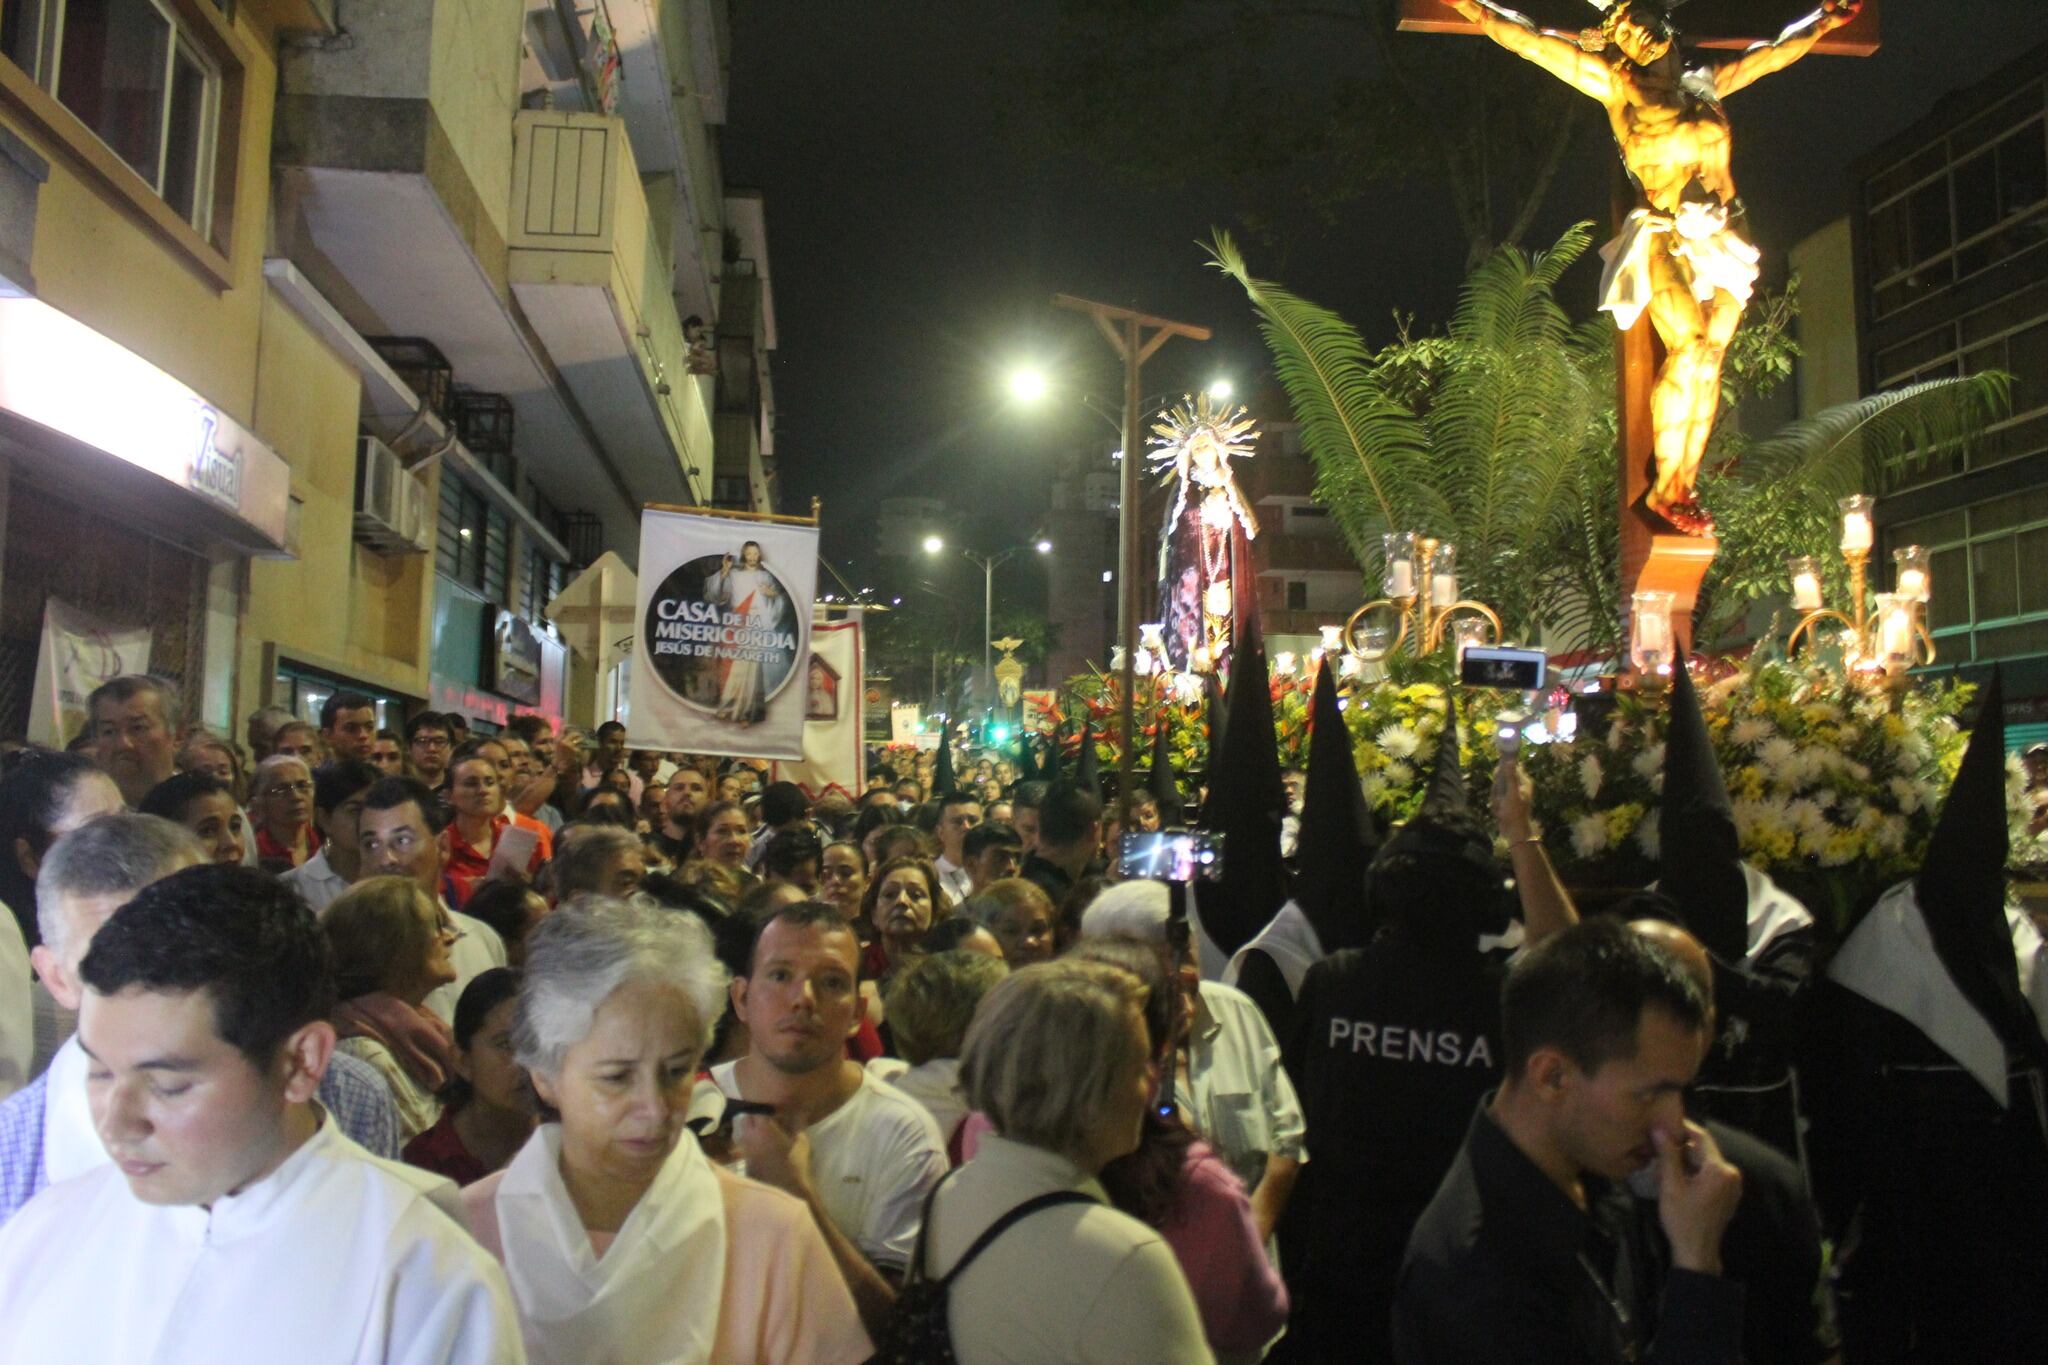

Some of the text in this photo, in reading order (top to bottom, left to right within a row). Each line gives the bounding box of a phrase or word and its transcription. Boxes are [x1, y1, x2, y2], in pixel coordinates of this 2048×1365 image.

[657, 599, 761, 627] CASA DE LA
[655, 622, 795, 650] MISERICORDIA
[654, 640, 780, 663] JESÚS DE NAZARETH
[1328, 1017, 1493, 1069] PRENSA
